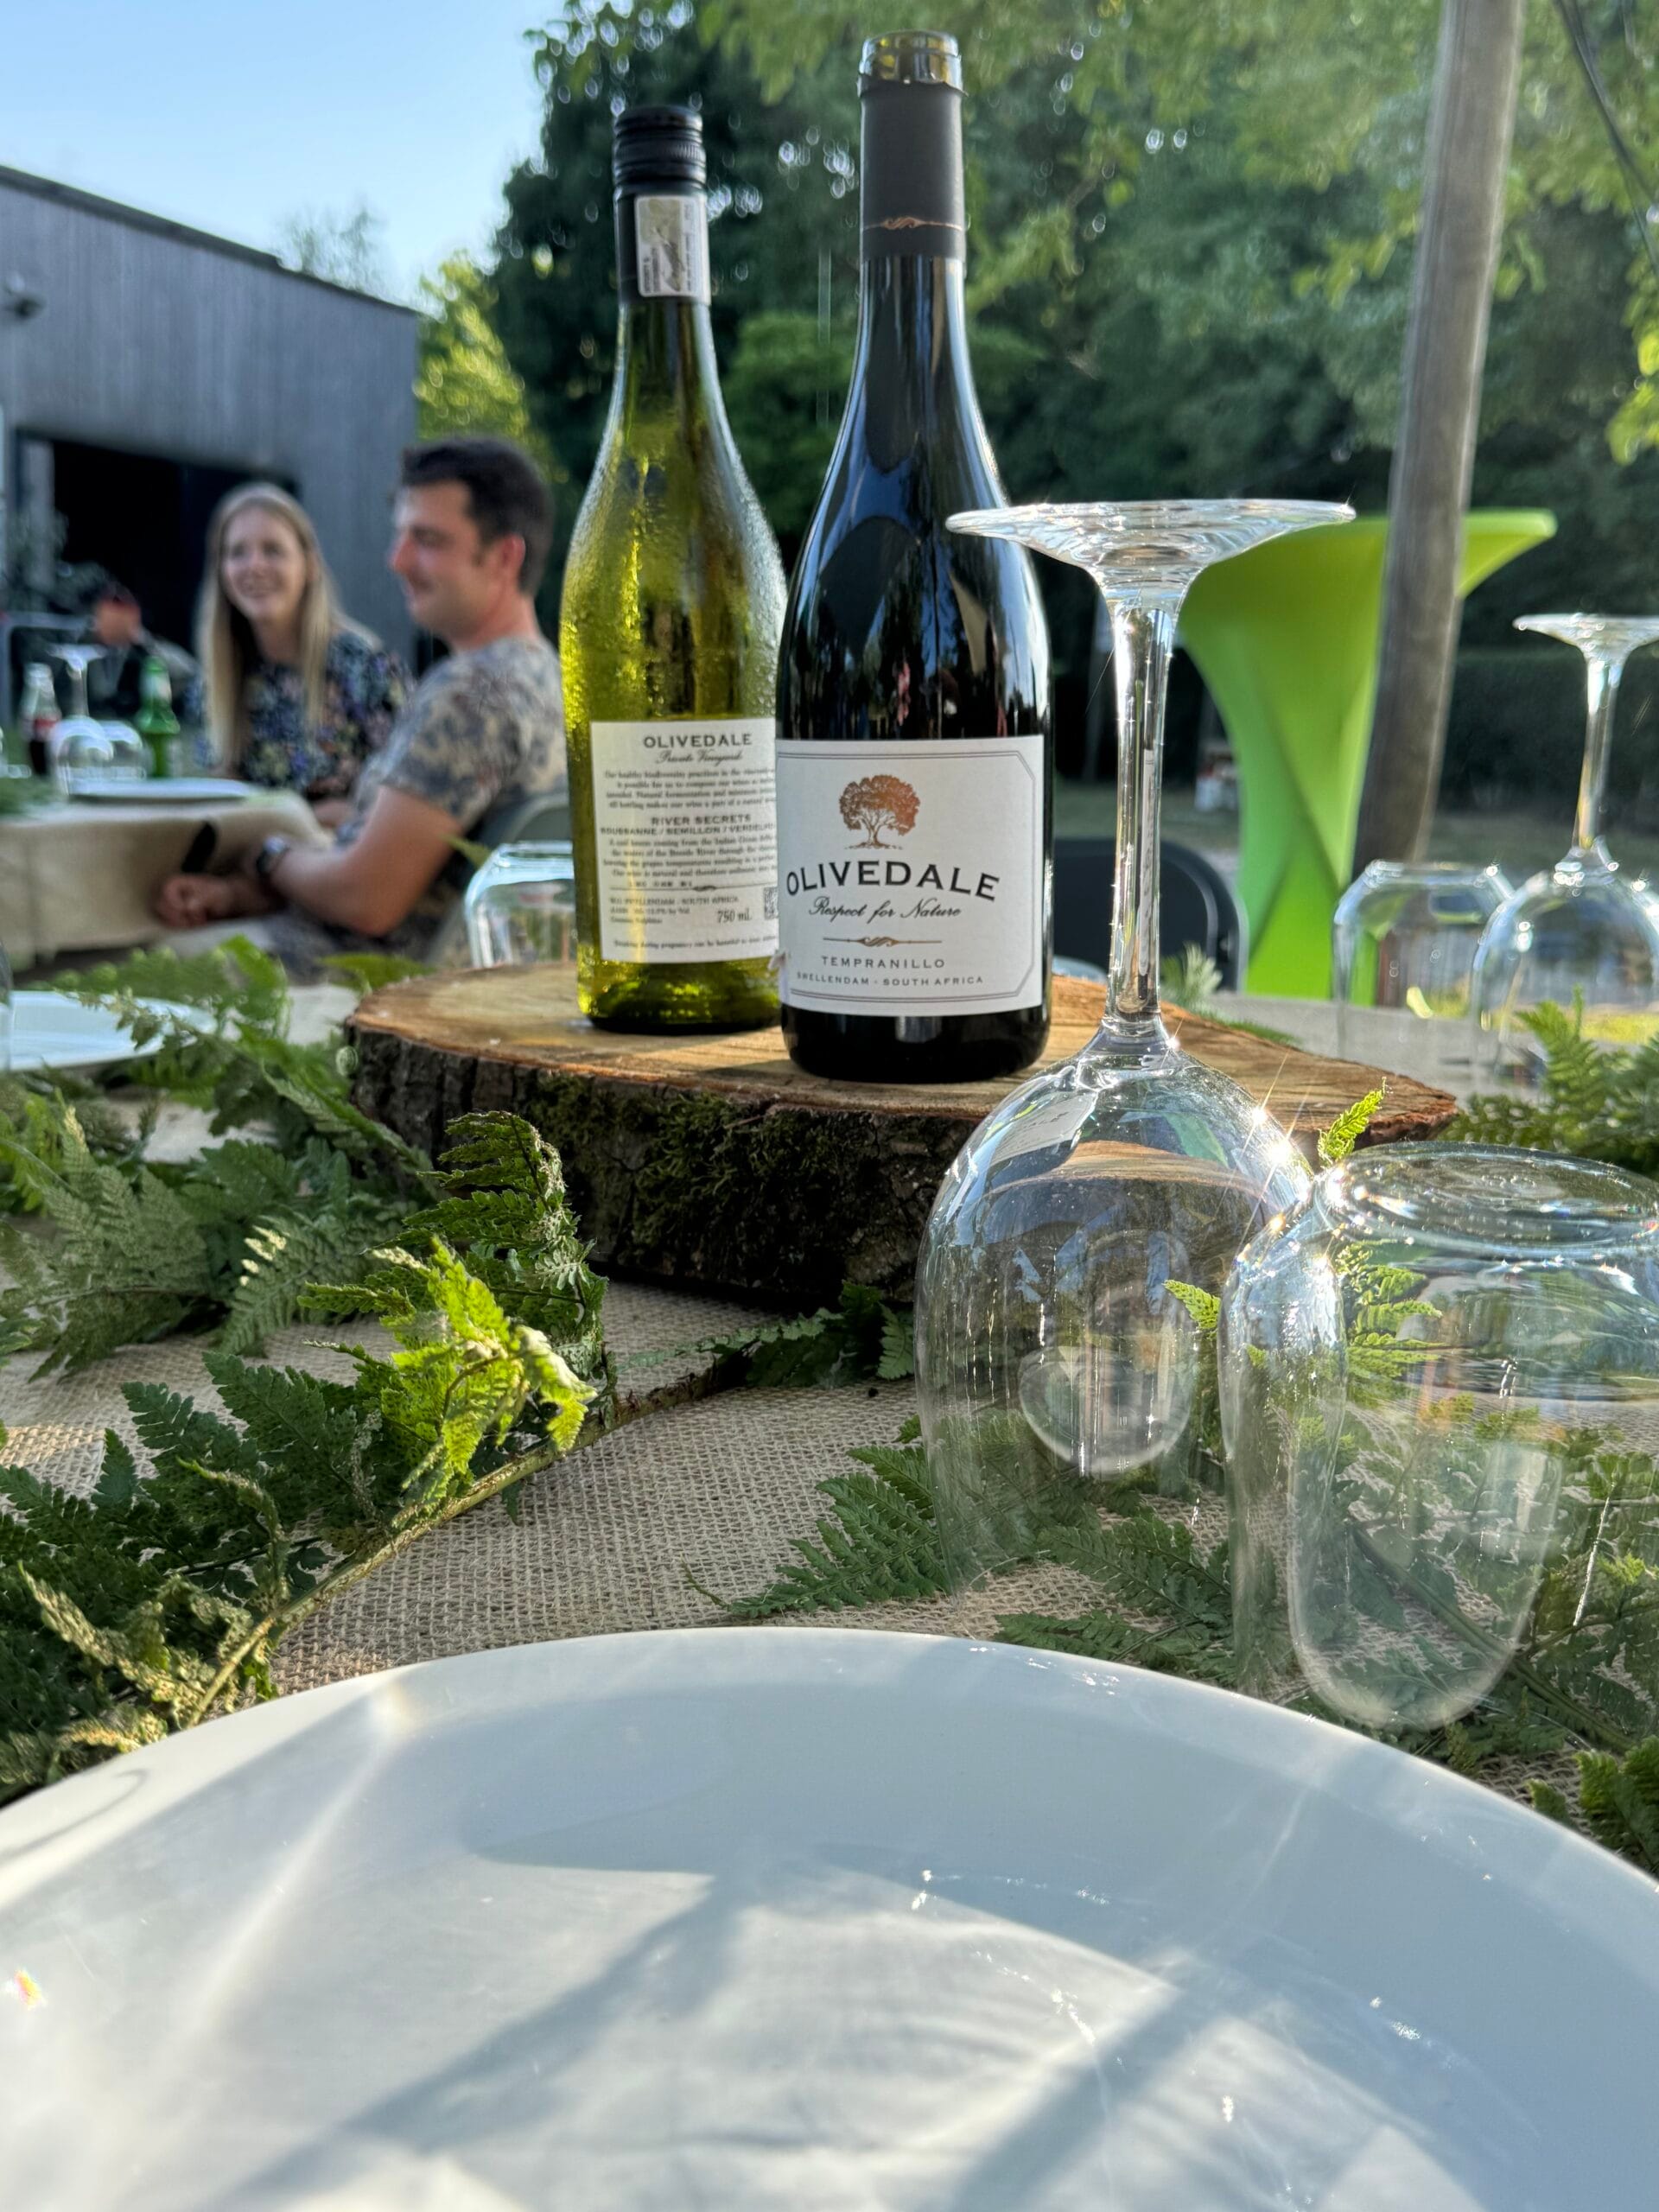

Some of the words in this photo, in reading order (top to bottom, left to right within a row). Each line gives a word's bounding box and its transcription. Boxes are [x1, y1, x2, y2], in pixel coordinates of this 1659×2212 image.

[644, 733, 753, 748] OLIVEDALE
[652, 817, 690, 826] RIVER
[695, 814, 751, 825] SECRETS
[666, 826, 721, 836] SEMILLON
[785, 859, 1001, 903] OLIVEDALE
[717, 910, 735, 924] 750
[808, 895, 868, 923] Respect
[868, 899, 897, 925] for
[900, 897, 963, 919] Nature
[821, 955, 946, 969] TEMPRANILLO
[797, 970, 869, 985] SWELLENDAM
[882, 977, 930, 988] SOUTH
[933, 976, 984, 987] AFRICA
